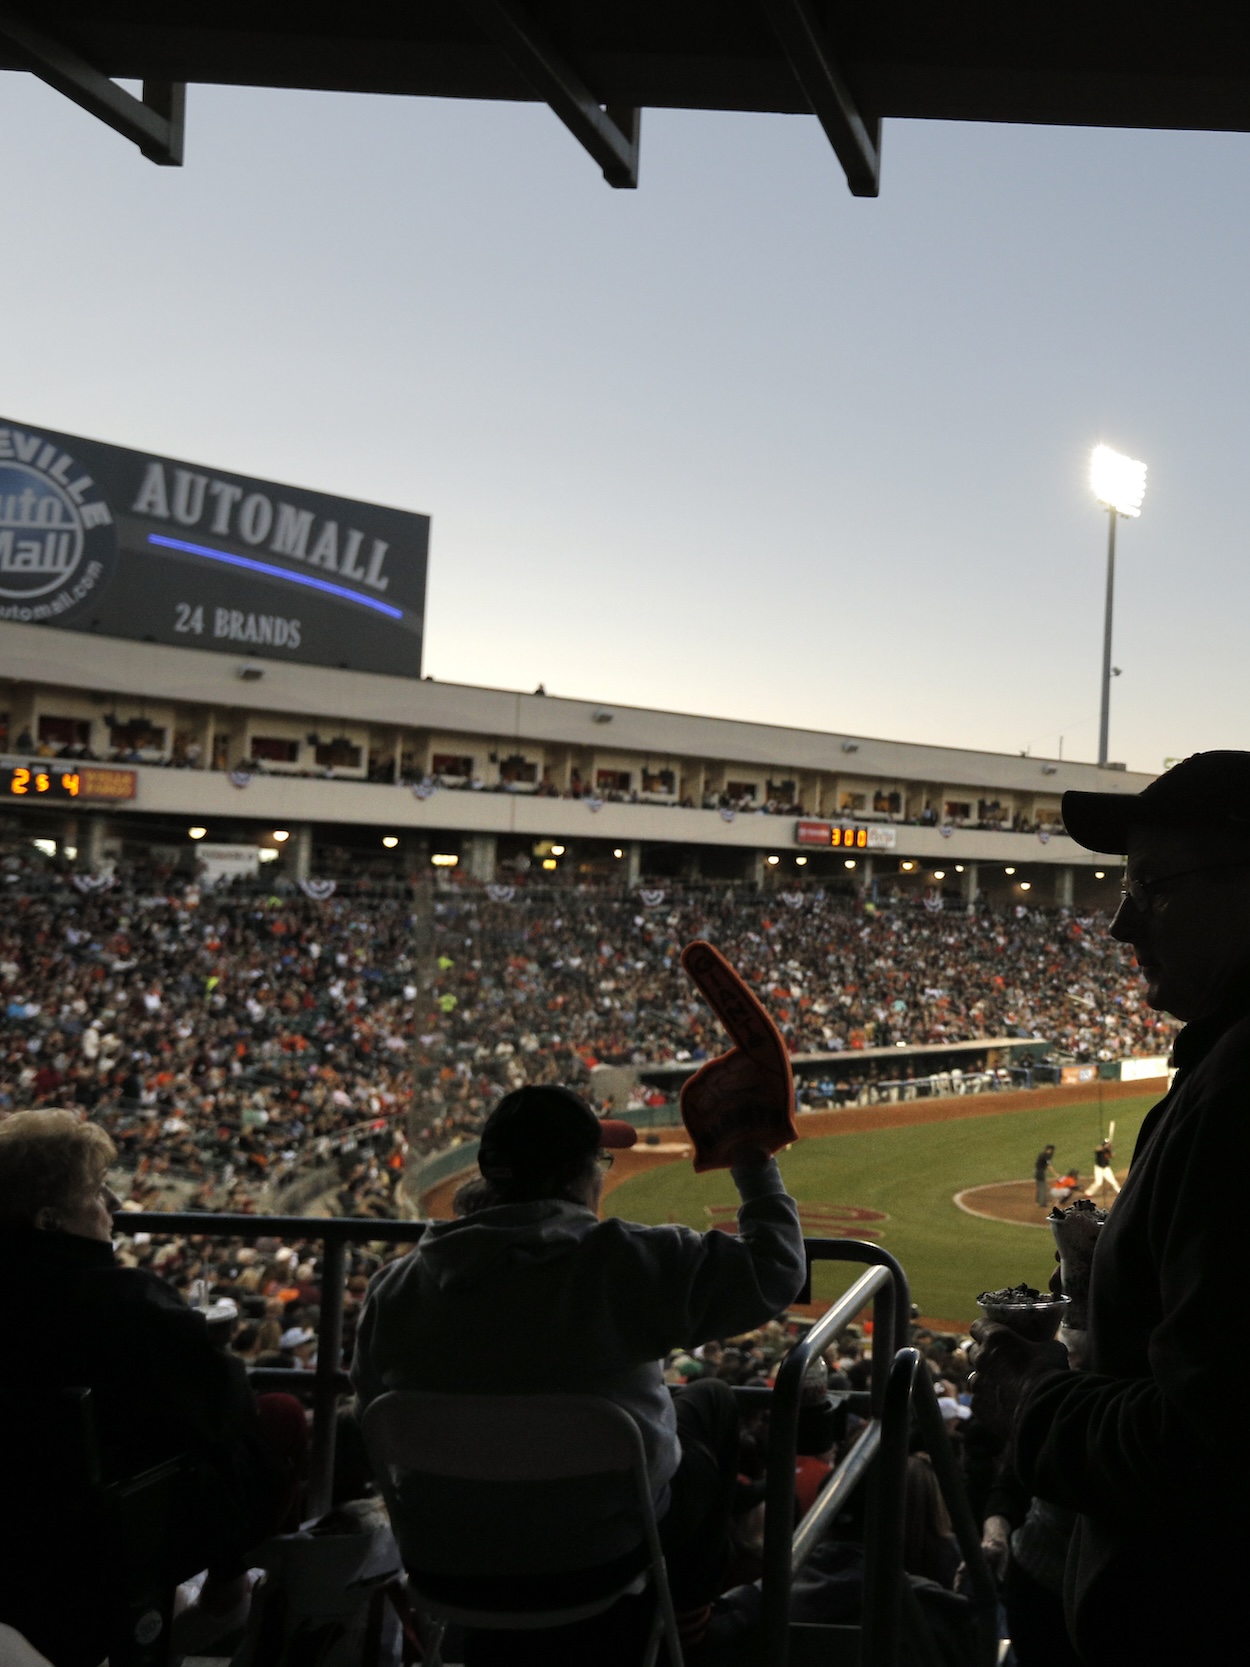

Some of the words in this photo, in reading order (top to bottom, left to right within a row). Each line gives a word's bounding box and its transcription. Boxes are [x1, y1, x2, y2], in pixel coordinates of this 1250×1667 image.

[132, 462, 391, 592] AUTOMALL
[174, 603, 205, 635] 24
[213, 607, 302, 650] BRANDS
[11, 768, 30, 794] 2
[61, 773, 80, 797] 4
[831, 827, 841, 846] 3
[844, 828, 854, 847] 0
[857, 829, 867, 848] 0
